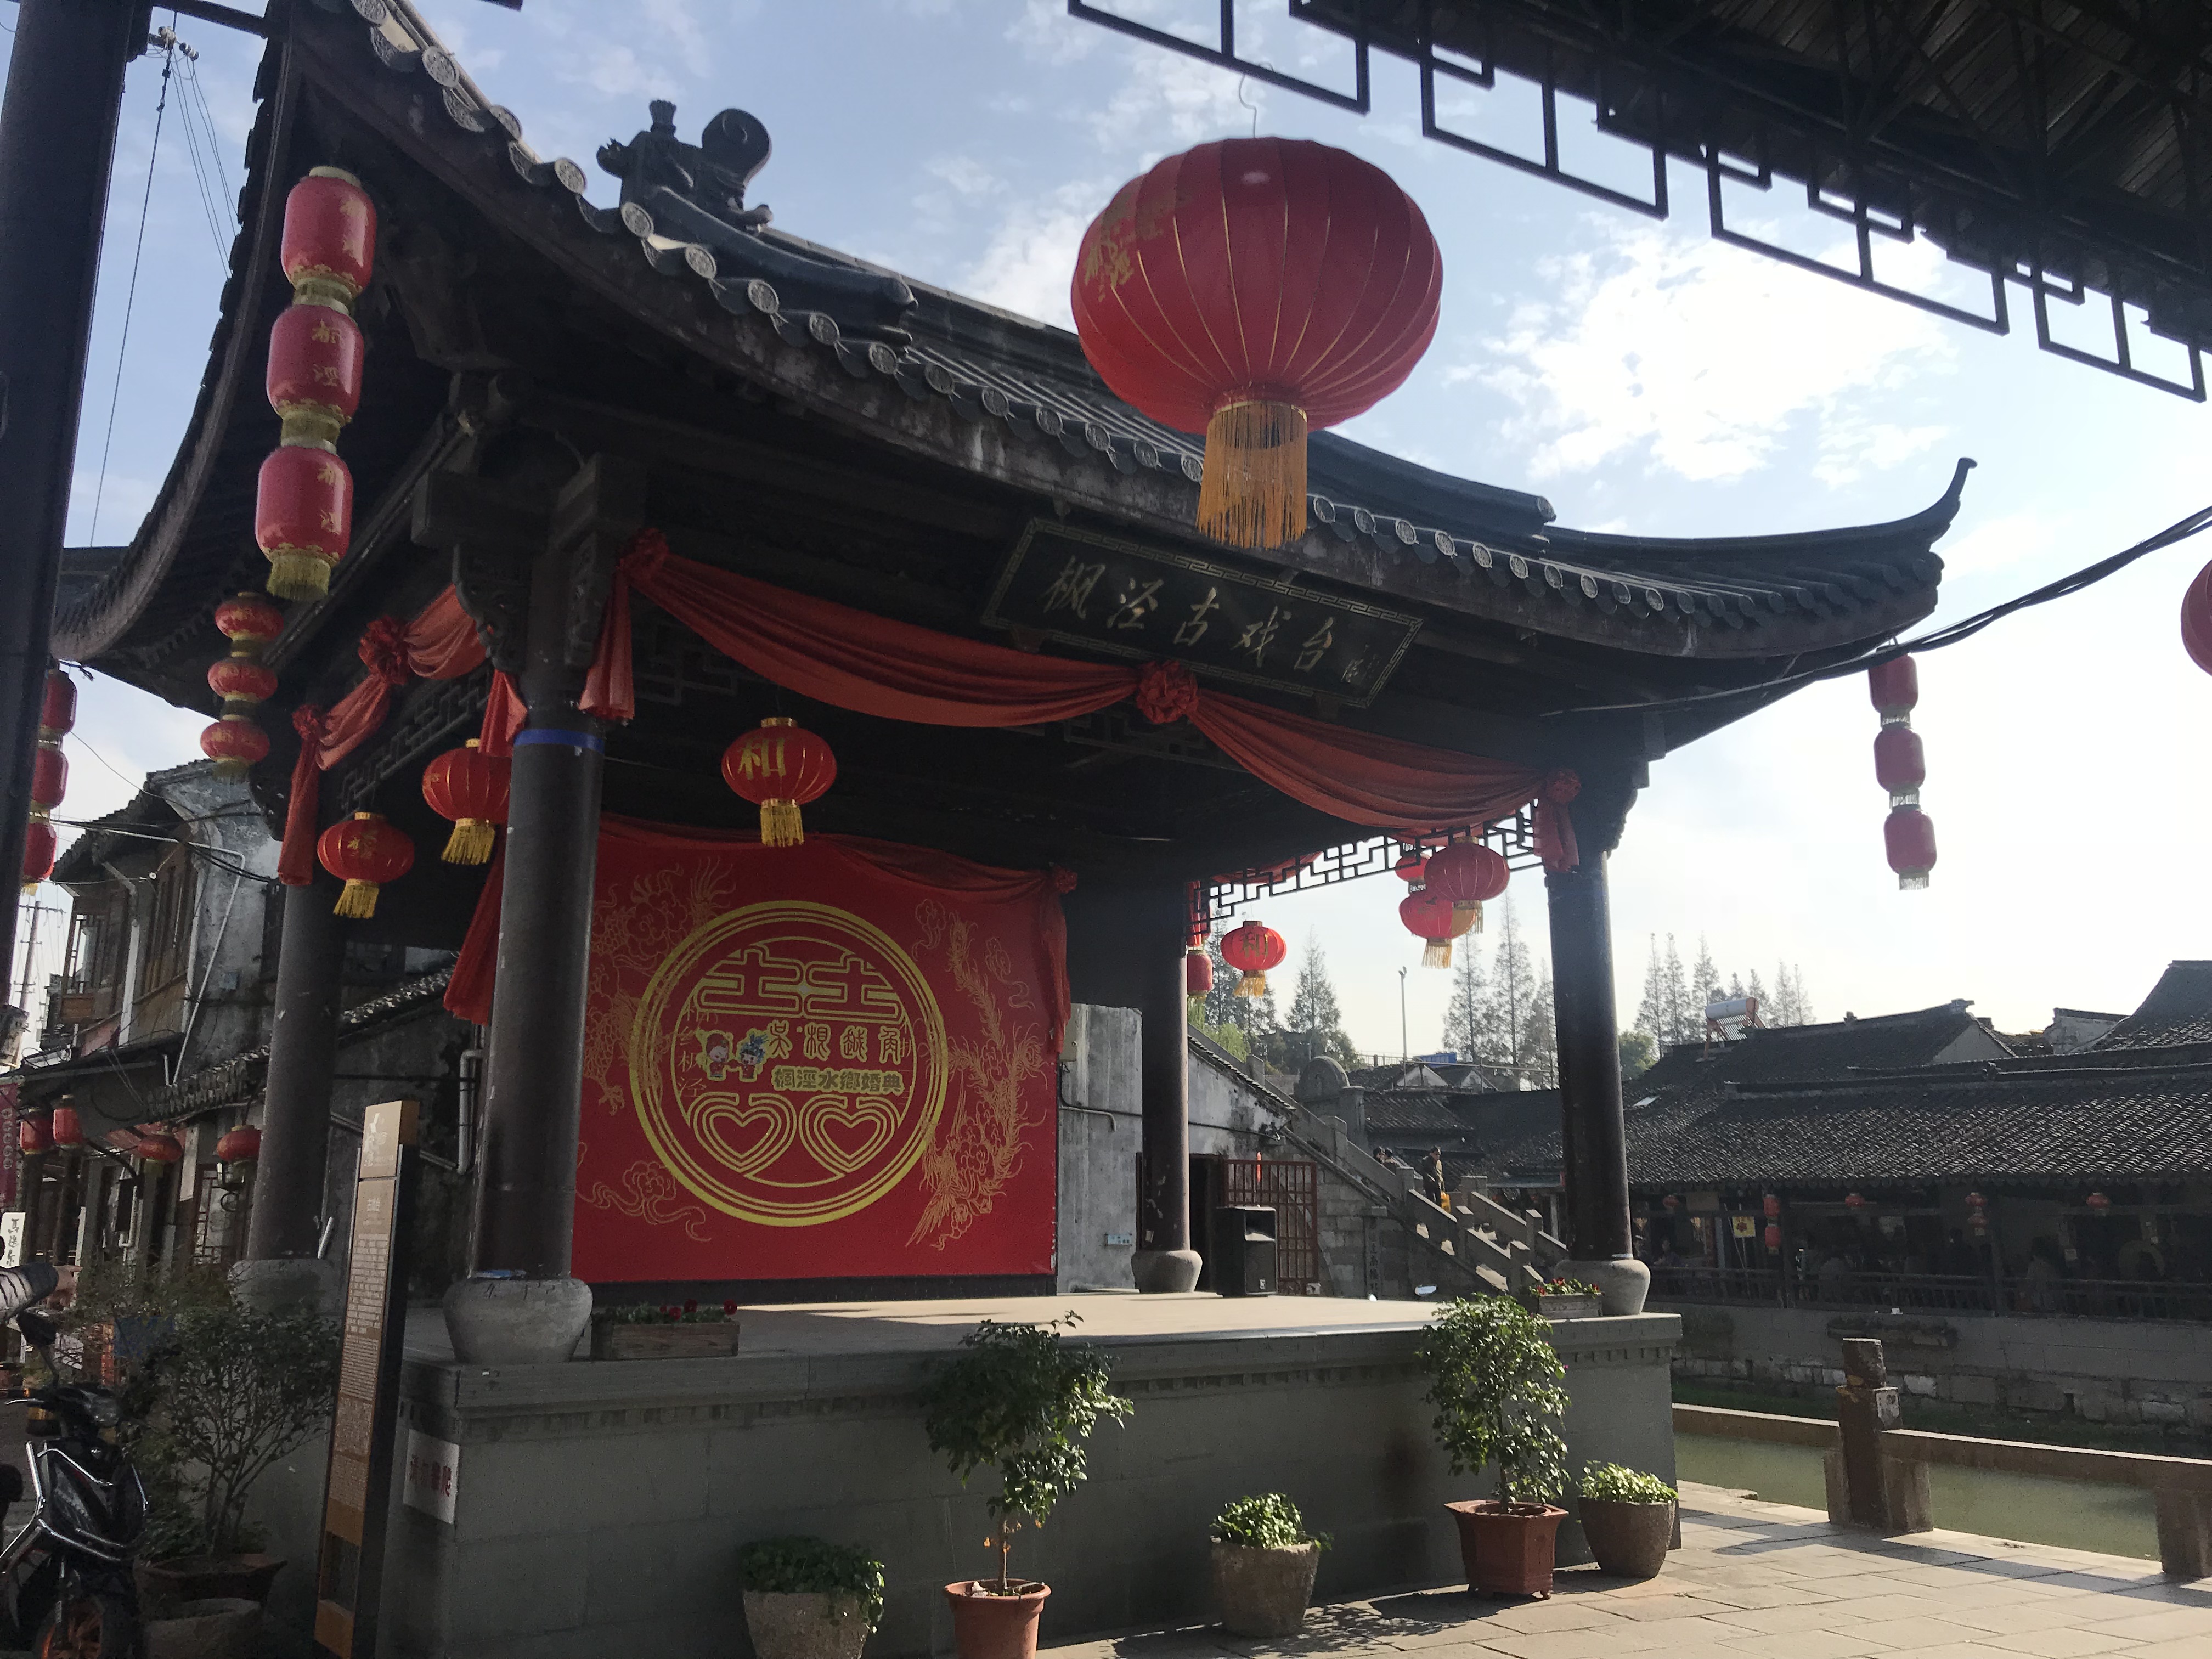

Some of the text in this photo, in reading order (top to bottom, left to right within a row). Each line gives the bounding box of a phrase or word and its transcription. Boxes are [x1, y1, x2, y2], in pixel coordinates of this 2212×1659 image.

[1043, 555, 1335, 674] 枫泾古戏台
